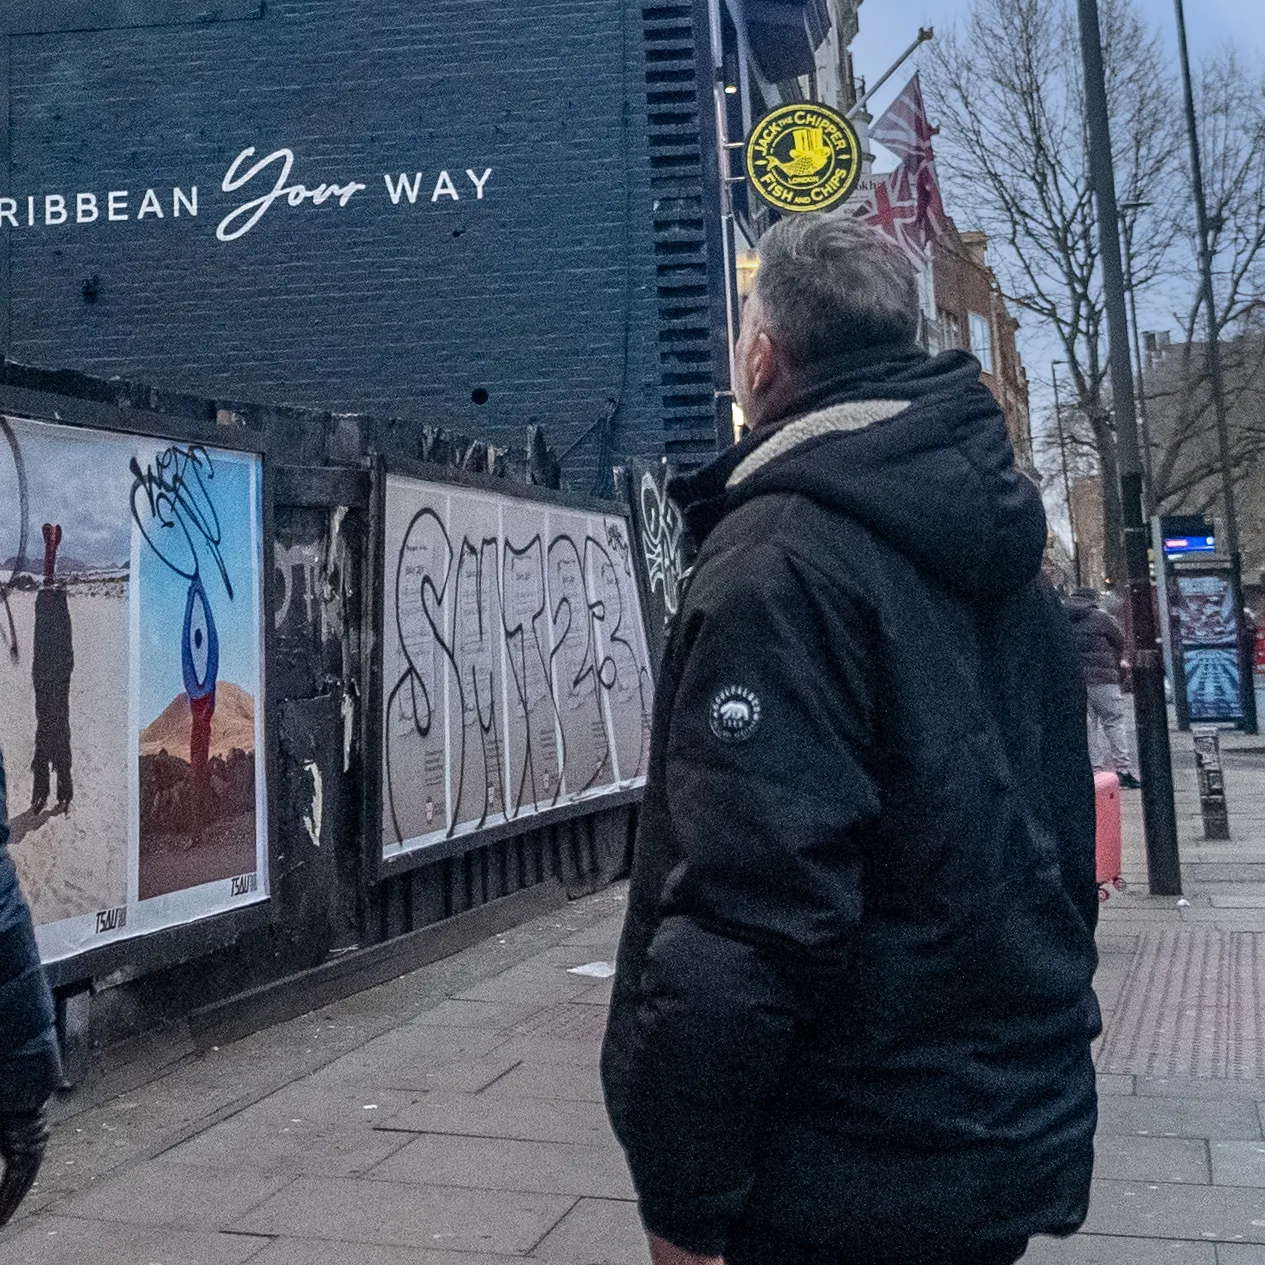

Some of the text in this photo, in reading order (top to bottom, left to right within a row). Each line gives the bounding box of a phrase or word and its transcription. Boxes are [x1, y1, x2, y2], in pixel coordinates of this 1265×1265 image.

[754, 122, 781, 156] JACK
[793, 111, 847, 150] CHIPPER
[216, 146, 366, 242] Your
[384, 167, 493, 204] WAY
[760, 173, 794, 202] FISH
[811, 168, 847, 201] CHIPS
[788, 176, 819, 184] LONDON
